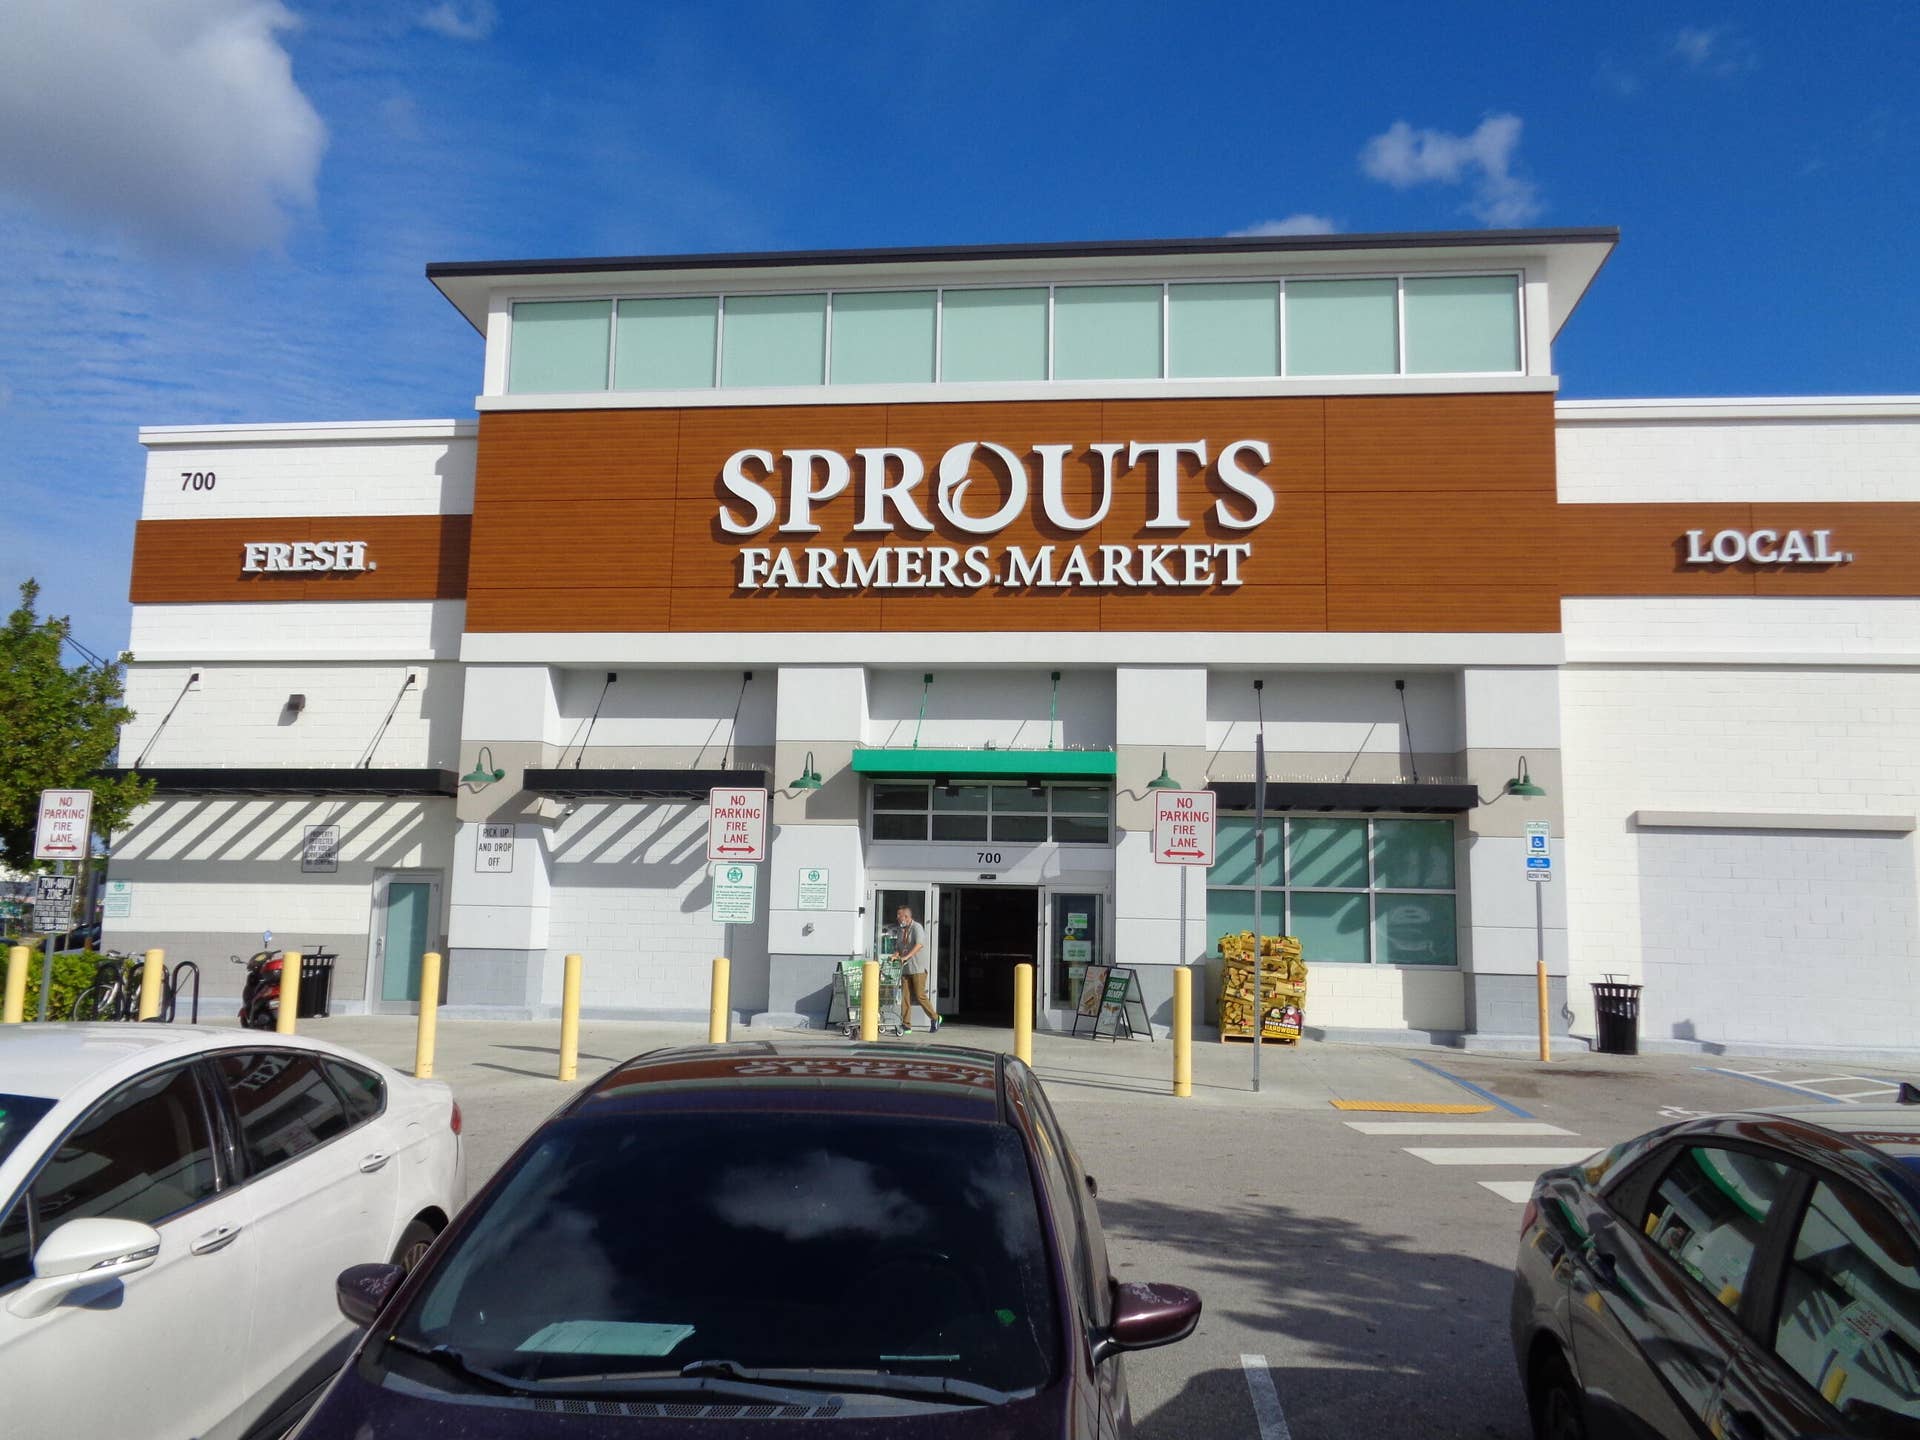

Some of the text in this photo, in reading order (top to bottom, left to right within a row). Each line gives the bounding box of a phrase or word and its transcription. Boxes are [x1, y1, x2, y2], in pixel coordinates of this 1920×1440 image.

[180, 472, 216, 491] 700
[719, 439, 1276, 535] SPROUTS
[1004, 543, 1251, 587] MARKET
[59, 797, 73, 807] NO
[731, 795, 746, 806] NO
[1177, 798, 1193, 809] NO
[44, 809, 85, 819] PARKING
[714, 808, 760, 819] PARKING
[1160, 811, 1209, 823] PARKING
[53, 822, 73, 831] FIRE
[726, 822, 748, 831] FIRE
[1173, 825, 1196, 835] FIRE
[483, 828, 509, 838] PICK UP
[50, 834, 73, 843] LANE
[723, 834, 749, 844] LANE
[1171, 838, 1197, 848] LANE
[479, 843, 512, 852] AND DROP
[488, 857, 500, 866] OFF
[977, 852, 1001, 864] 700
